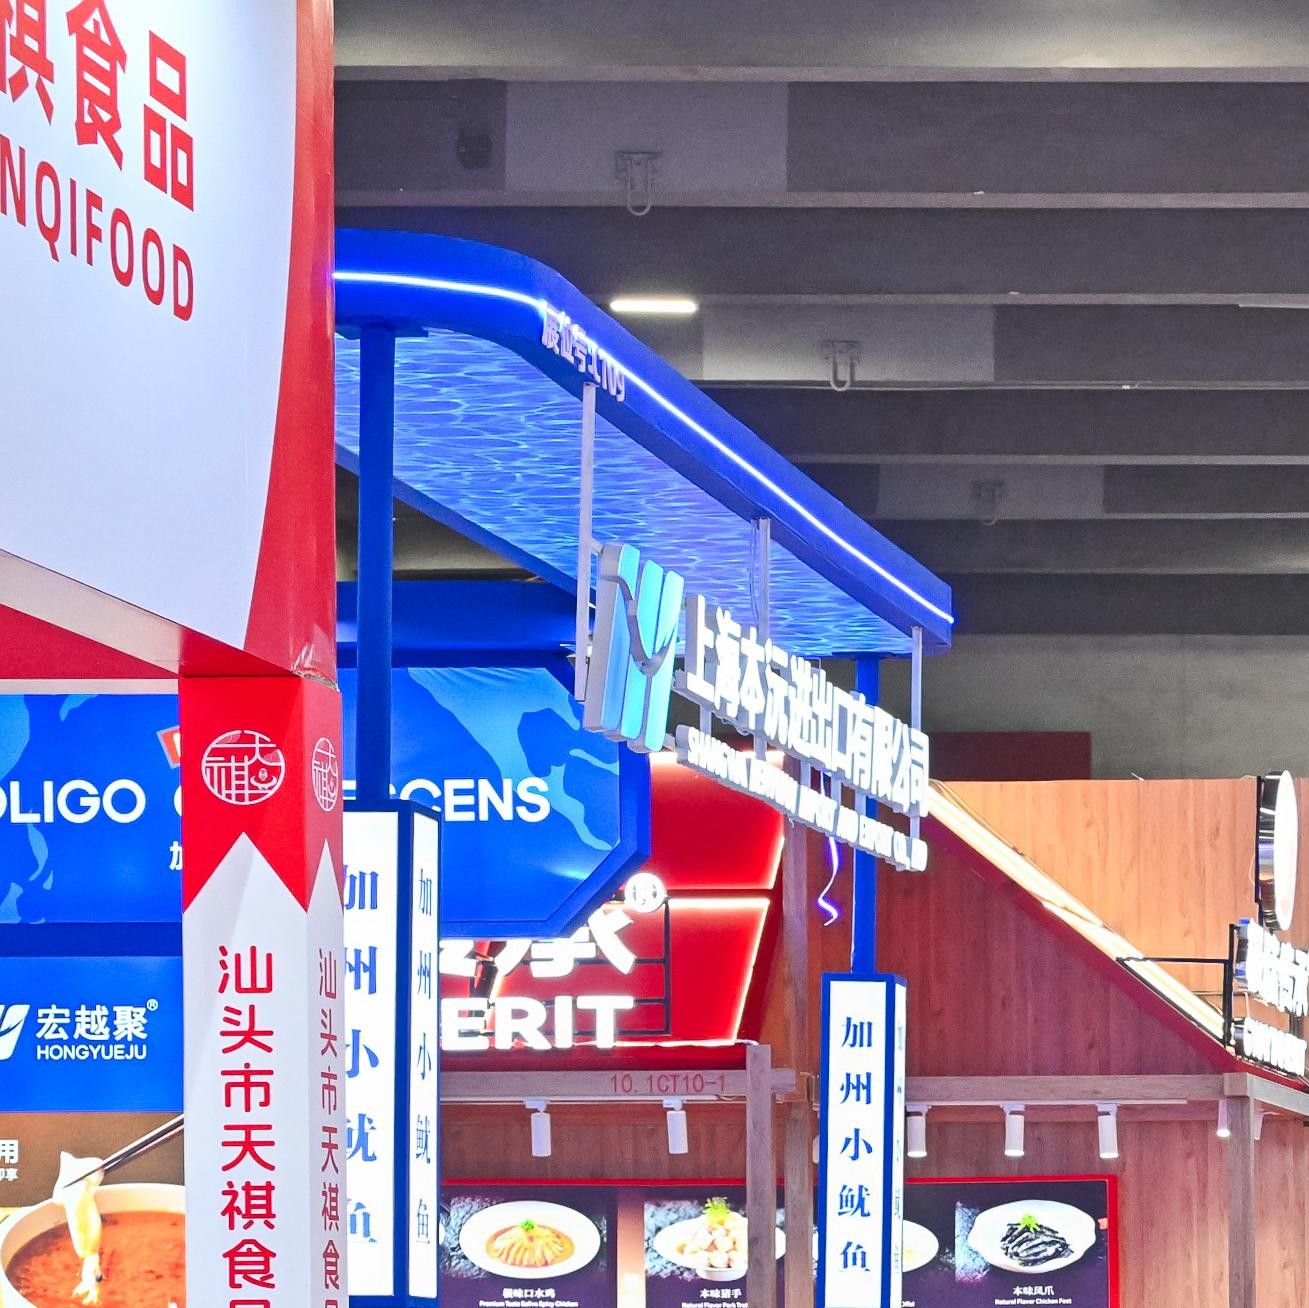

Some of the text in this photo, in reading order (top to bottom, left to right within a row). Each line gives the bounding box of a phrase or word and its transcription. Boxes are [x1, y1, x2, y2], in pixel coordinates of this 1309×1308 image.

[0, 135, 194, 321] NQIFOOD
[0, 779, 146, 824] LIGO
[36, 1004, 149, 1043] 宏越聚
[36, 1045, 148, 1061] HONGYUEJU
[609, 1073, 727, 1095] 10.1CT10-1
[837, 1016, 873, 1273] 加州小鱿鱼
